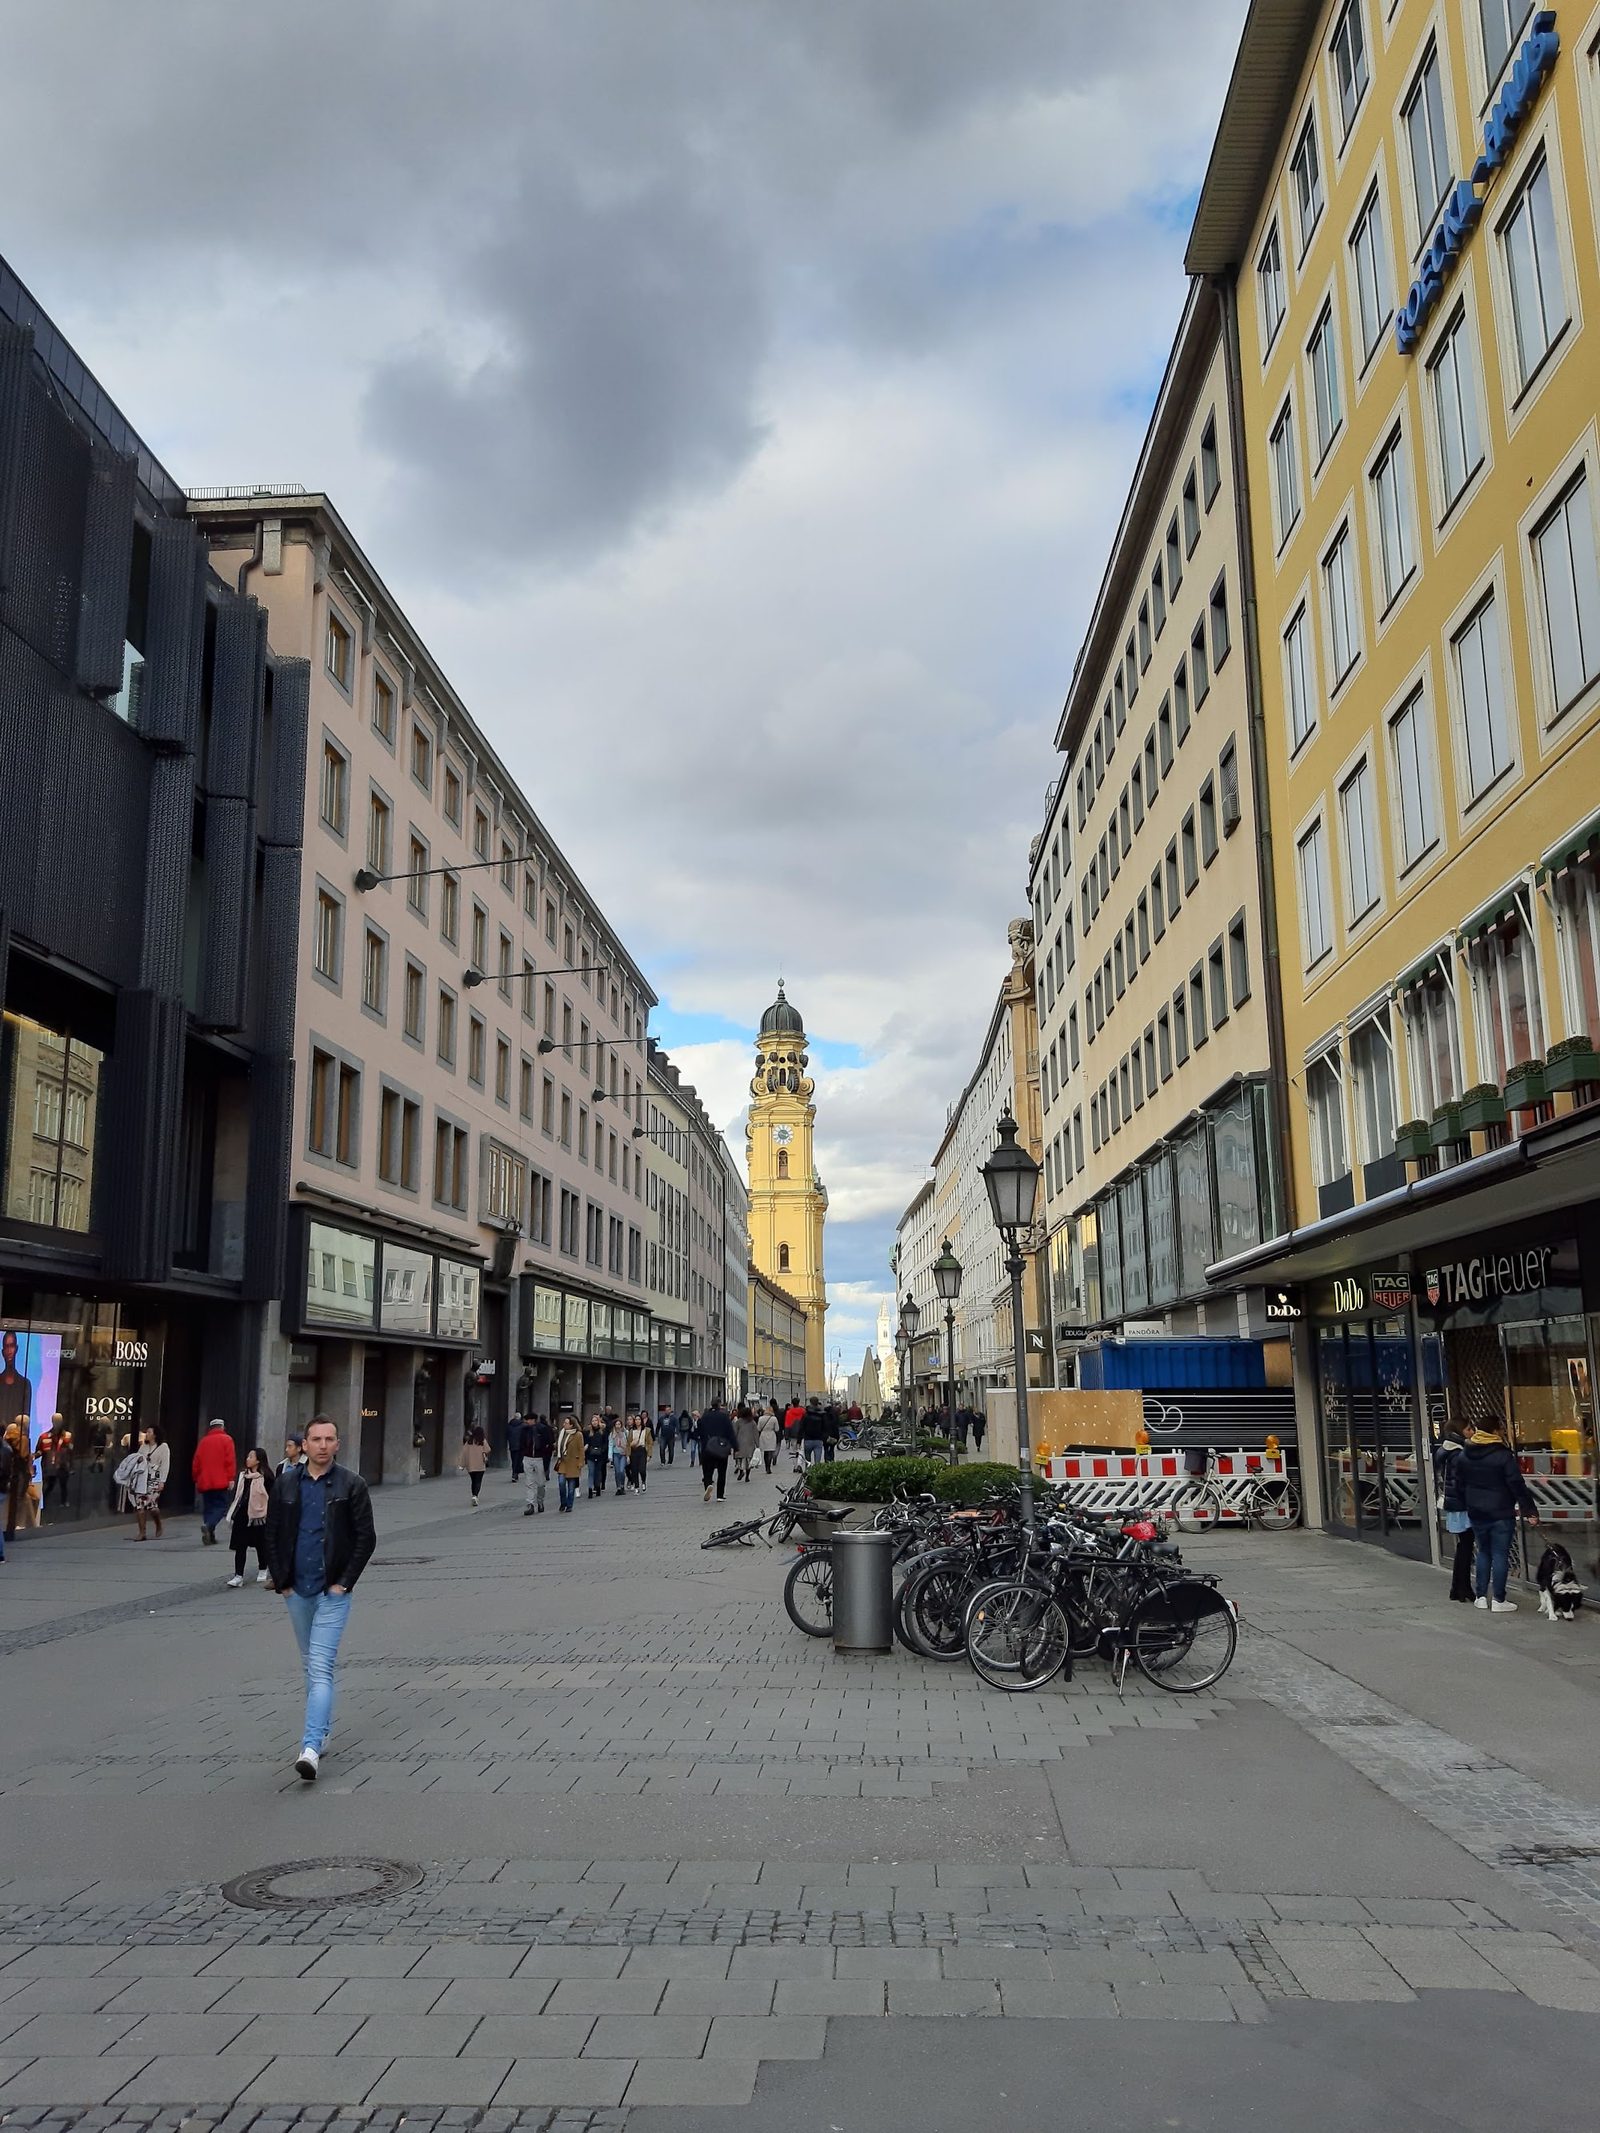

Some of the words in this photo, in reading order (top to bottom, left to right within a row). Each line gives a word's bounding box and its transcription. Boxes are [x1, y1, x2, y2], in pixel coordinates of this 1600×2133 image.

[1374, 1277, 1408, 1288] TAG
[1333, 1278, 1364, 1313] DoDo
[1375, 1291, 1410, 1307] HEUER
[1267, 1304, 1301, 1317] DoDo
[115, 1340, 148, 1361] BOSS
